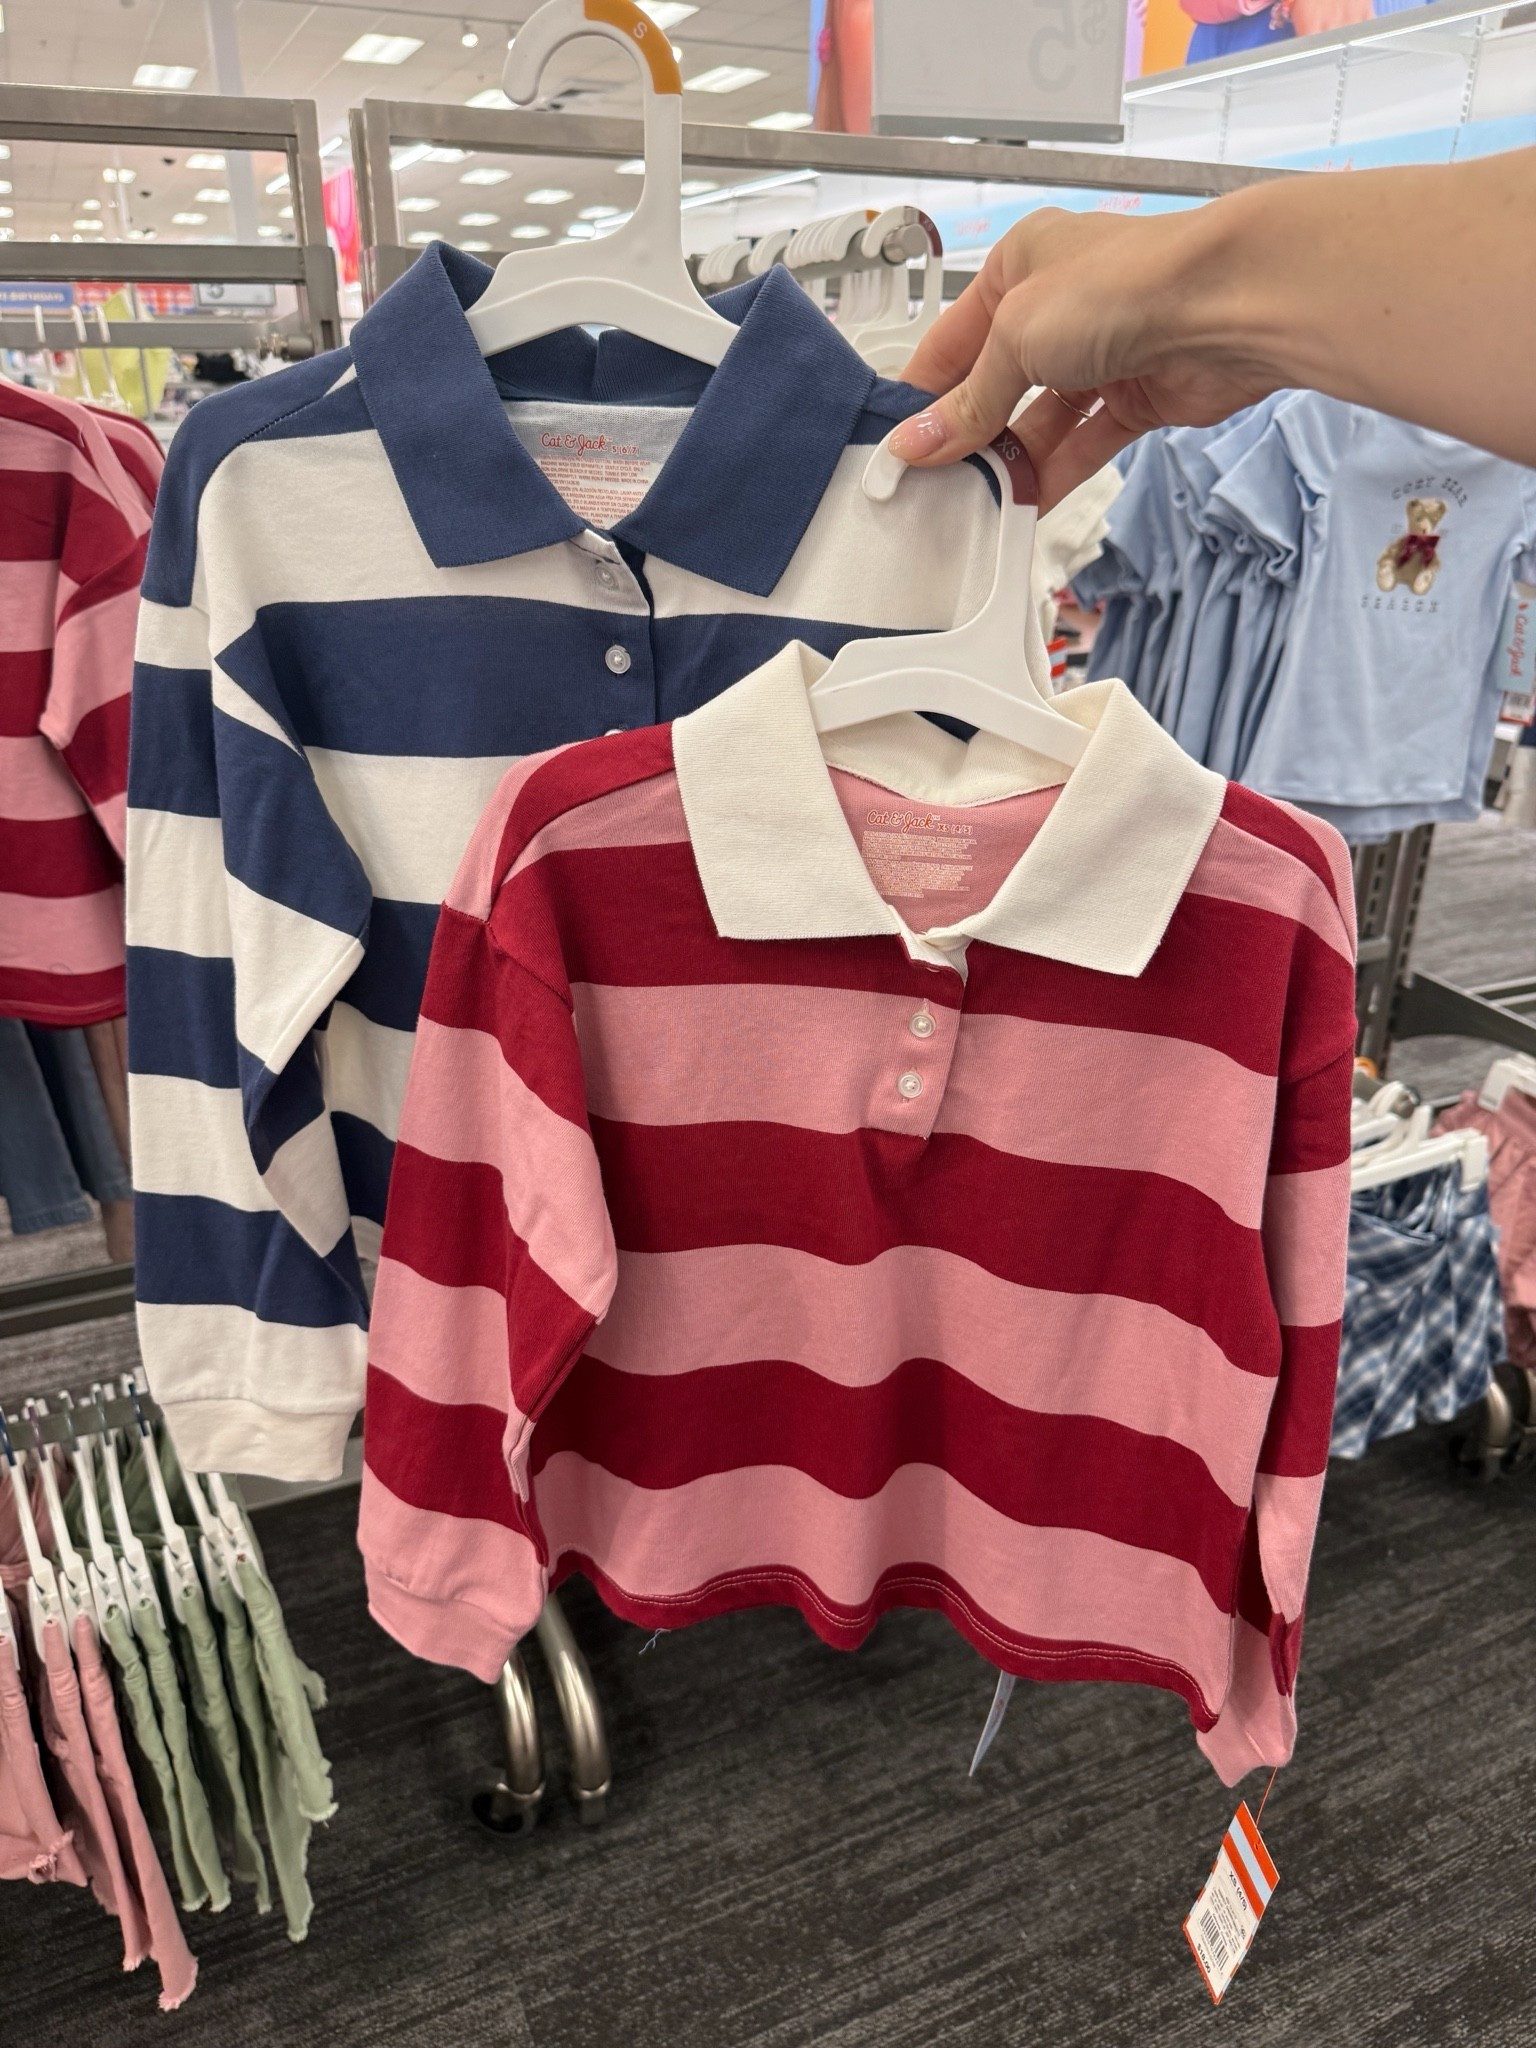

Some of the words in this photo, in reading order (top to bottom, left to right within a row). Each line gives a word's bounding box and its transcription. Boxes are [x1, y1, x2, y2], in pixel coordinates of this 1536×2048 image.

[633, 21, 648, 39] S
[541, 432, 561, 448] Cat
[564, 434, 577, 448] &
[578, 434, 606, 456] Jack
[996, 435, 1020, 461] XS
[867, 811, 889, 826] Cat
[890, 811, 903, 826] &
[902, 811, 934, 833] Jack
[937, 824, 950, 833] XS
[951, 824, 973, 835] (4/5)
